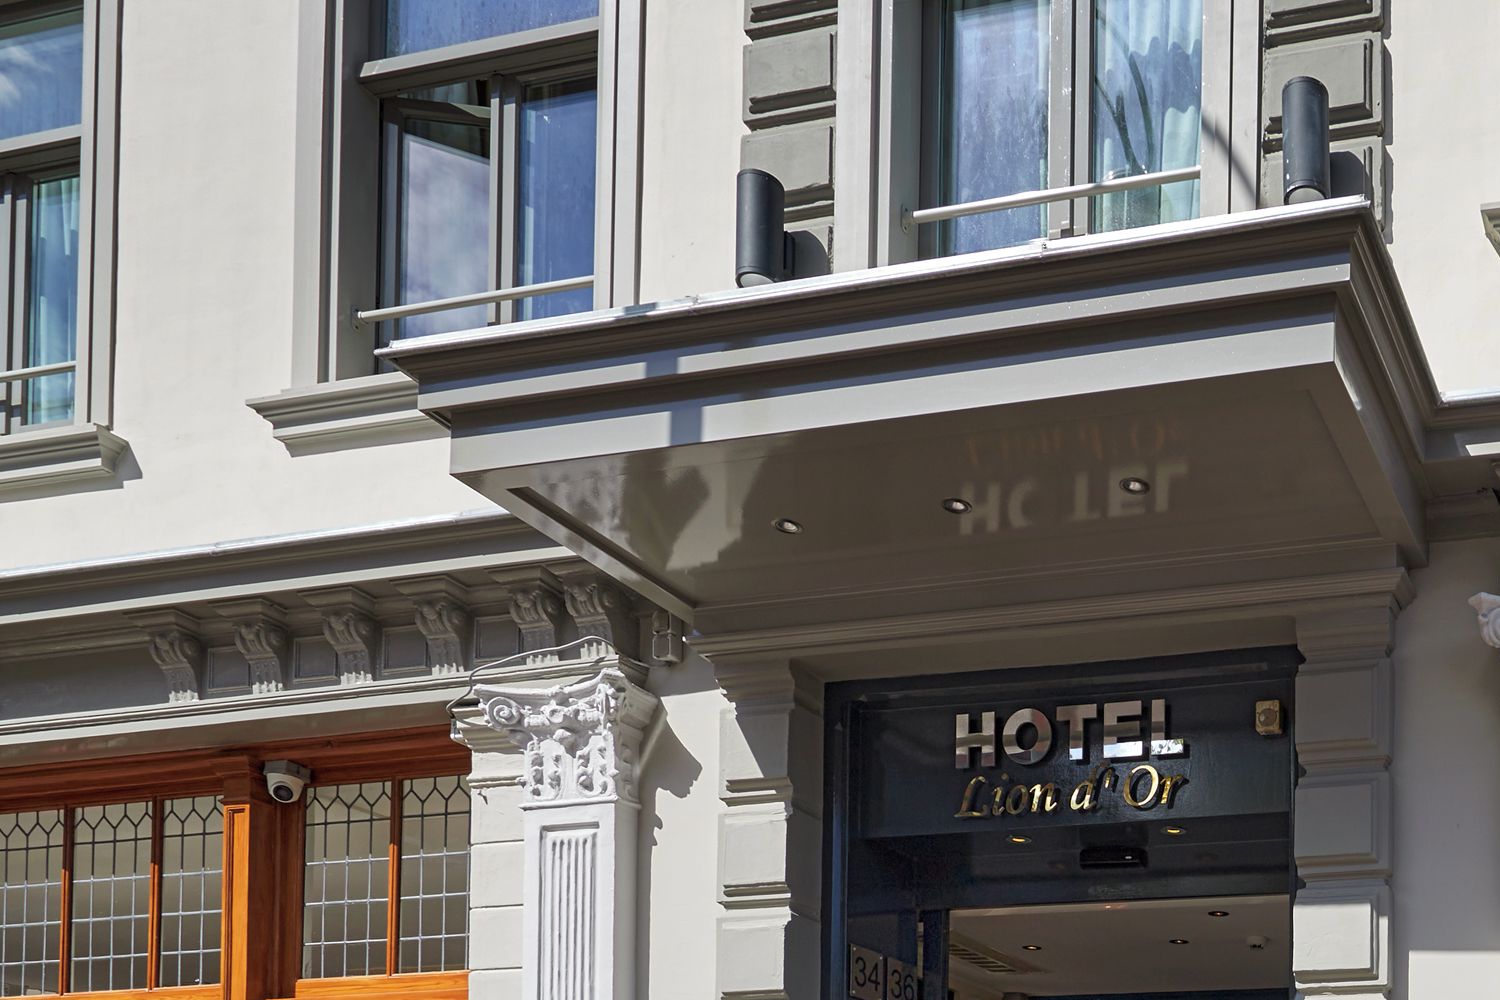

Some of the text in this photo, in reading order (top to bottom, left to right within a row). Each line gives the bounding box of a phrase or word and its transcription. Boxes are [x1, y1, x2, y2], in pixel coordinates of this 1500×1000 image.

[955, 699, 1185, 769] HOTEL
[954, 773, 1058, 818] Lion
[854, 956, 880, 992] 34
